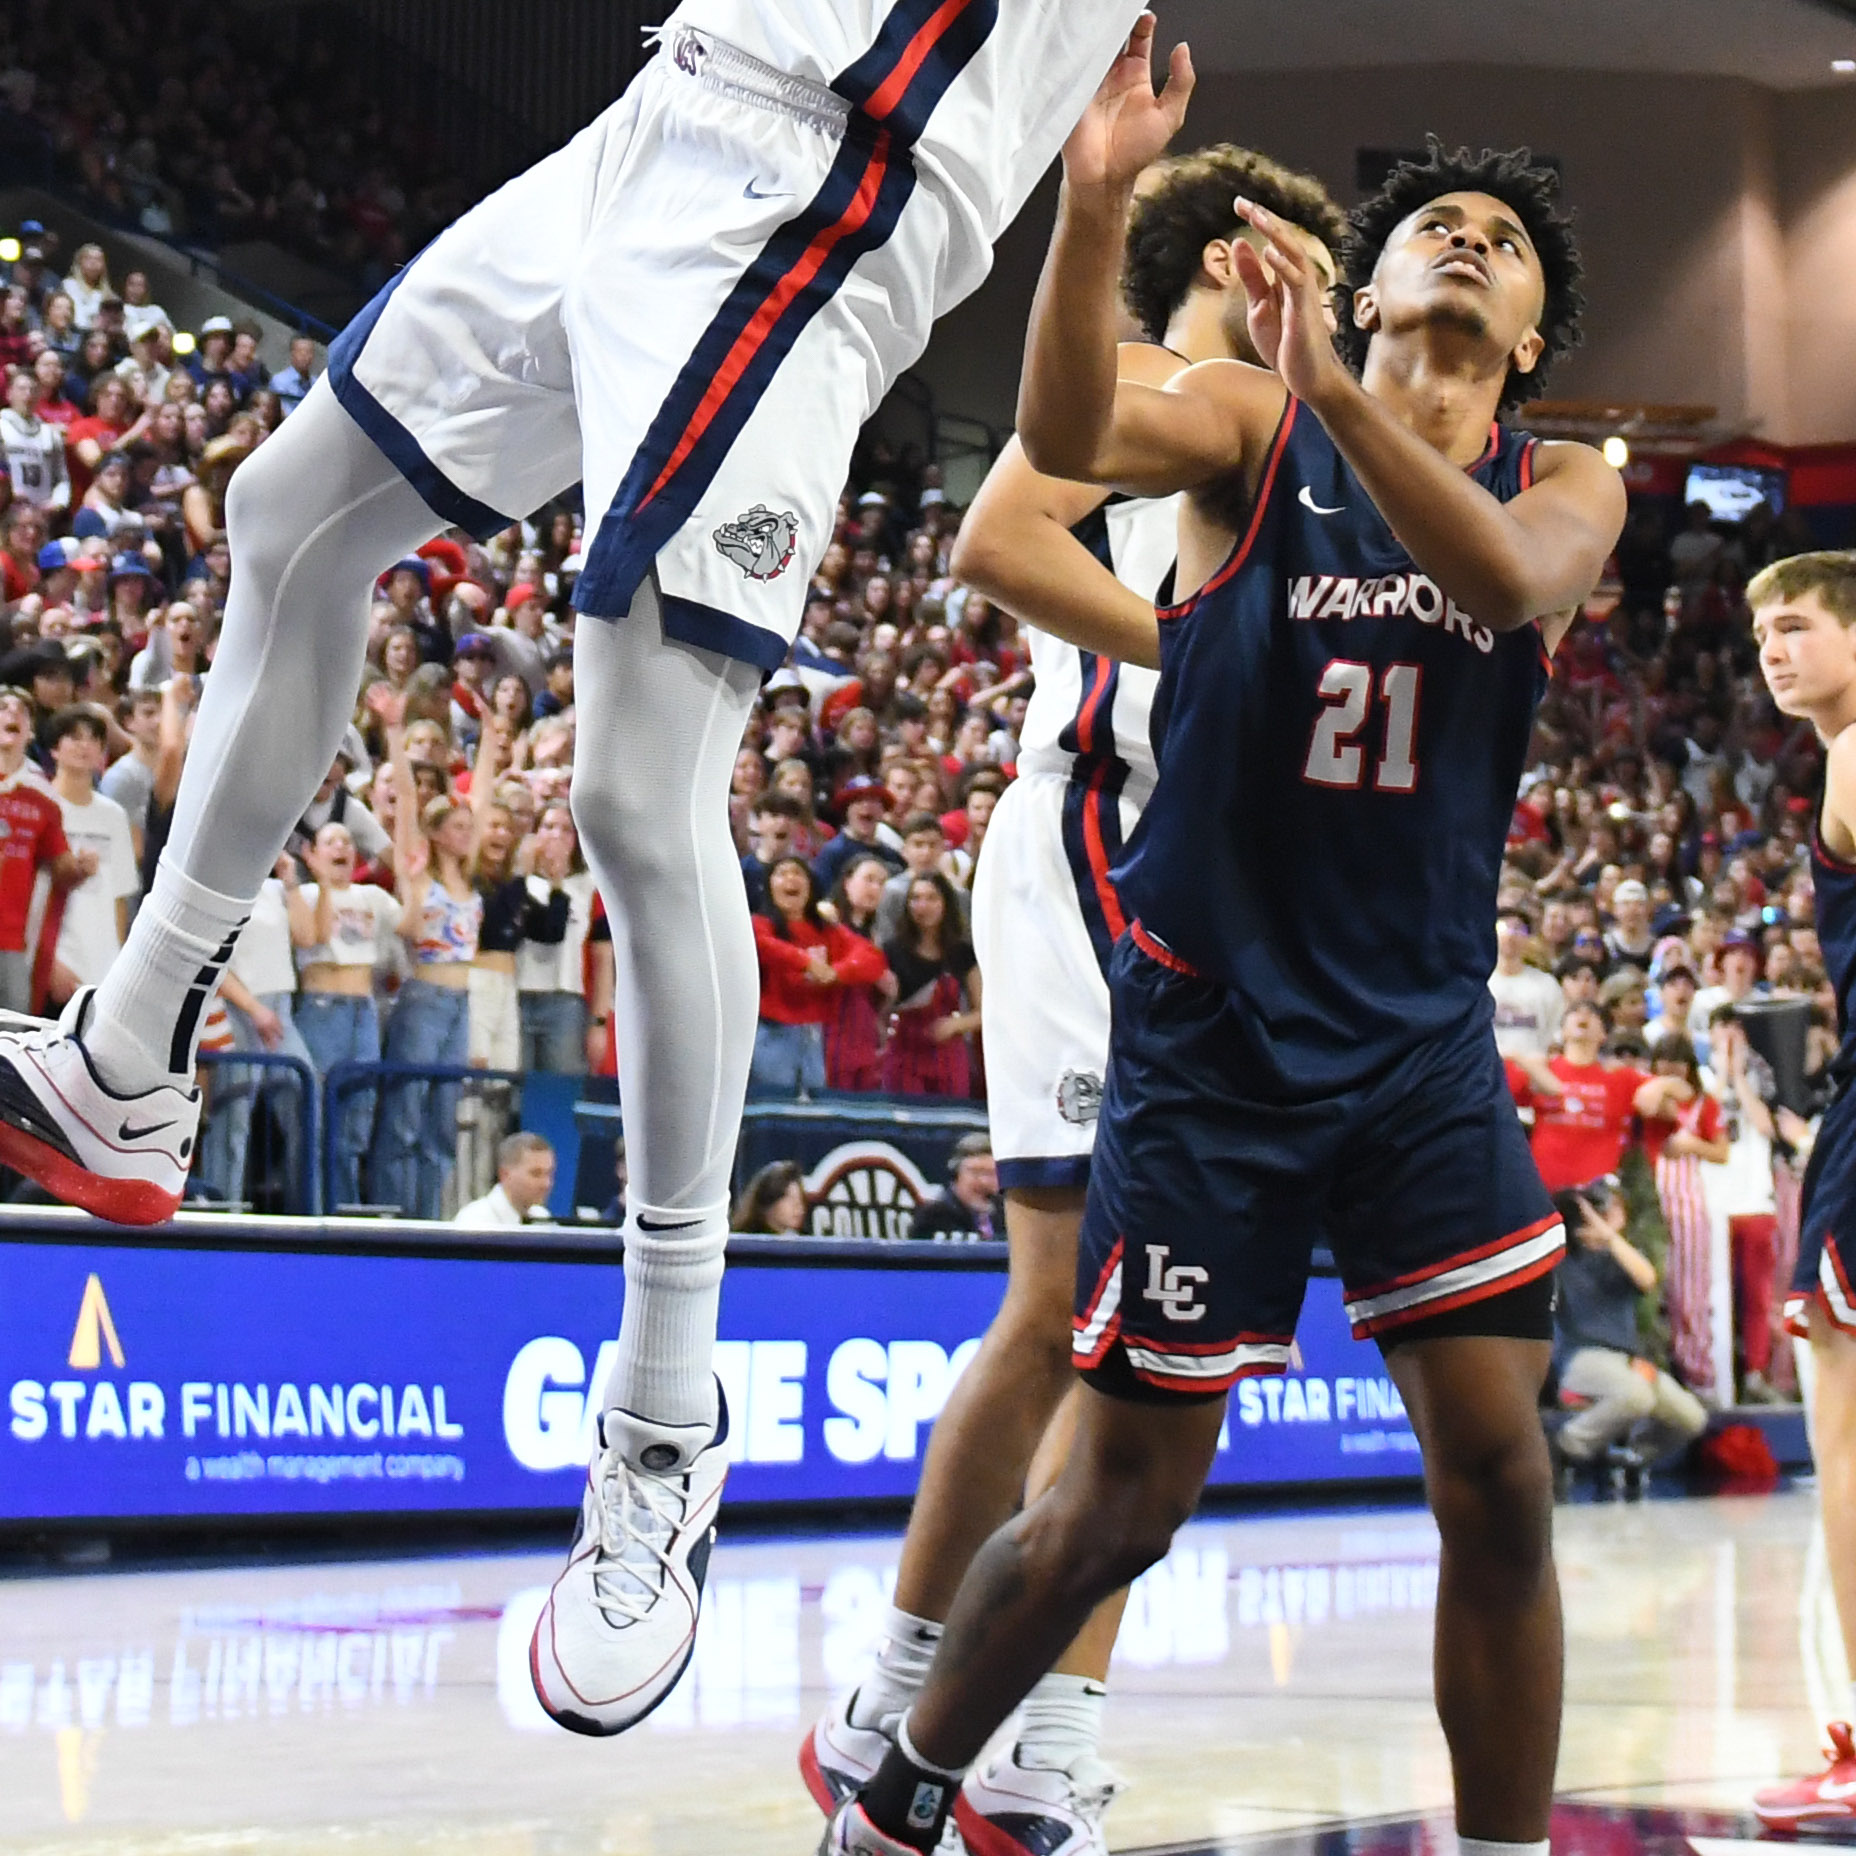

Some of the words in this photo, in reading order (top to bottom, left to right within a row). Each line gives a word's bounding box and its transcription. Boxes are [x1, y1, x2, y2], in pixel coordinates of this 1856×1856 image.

[1301, 657, 1424, 794] 21
[1142, 1242, 1210, 1323] LC
[10, 1379, 166, 1439] STAR
[181, 1381, 464, 1439] FINANCIAL
[1237, 1376, 1331, 1426] STAR
